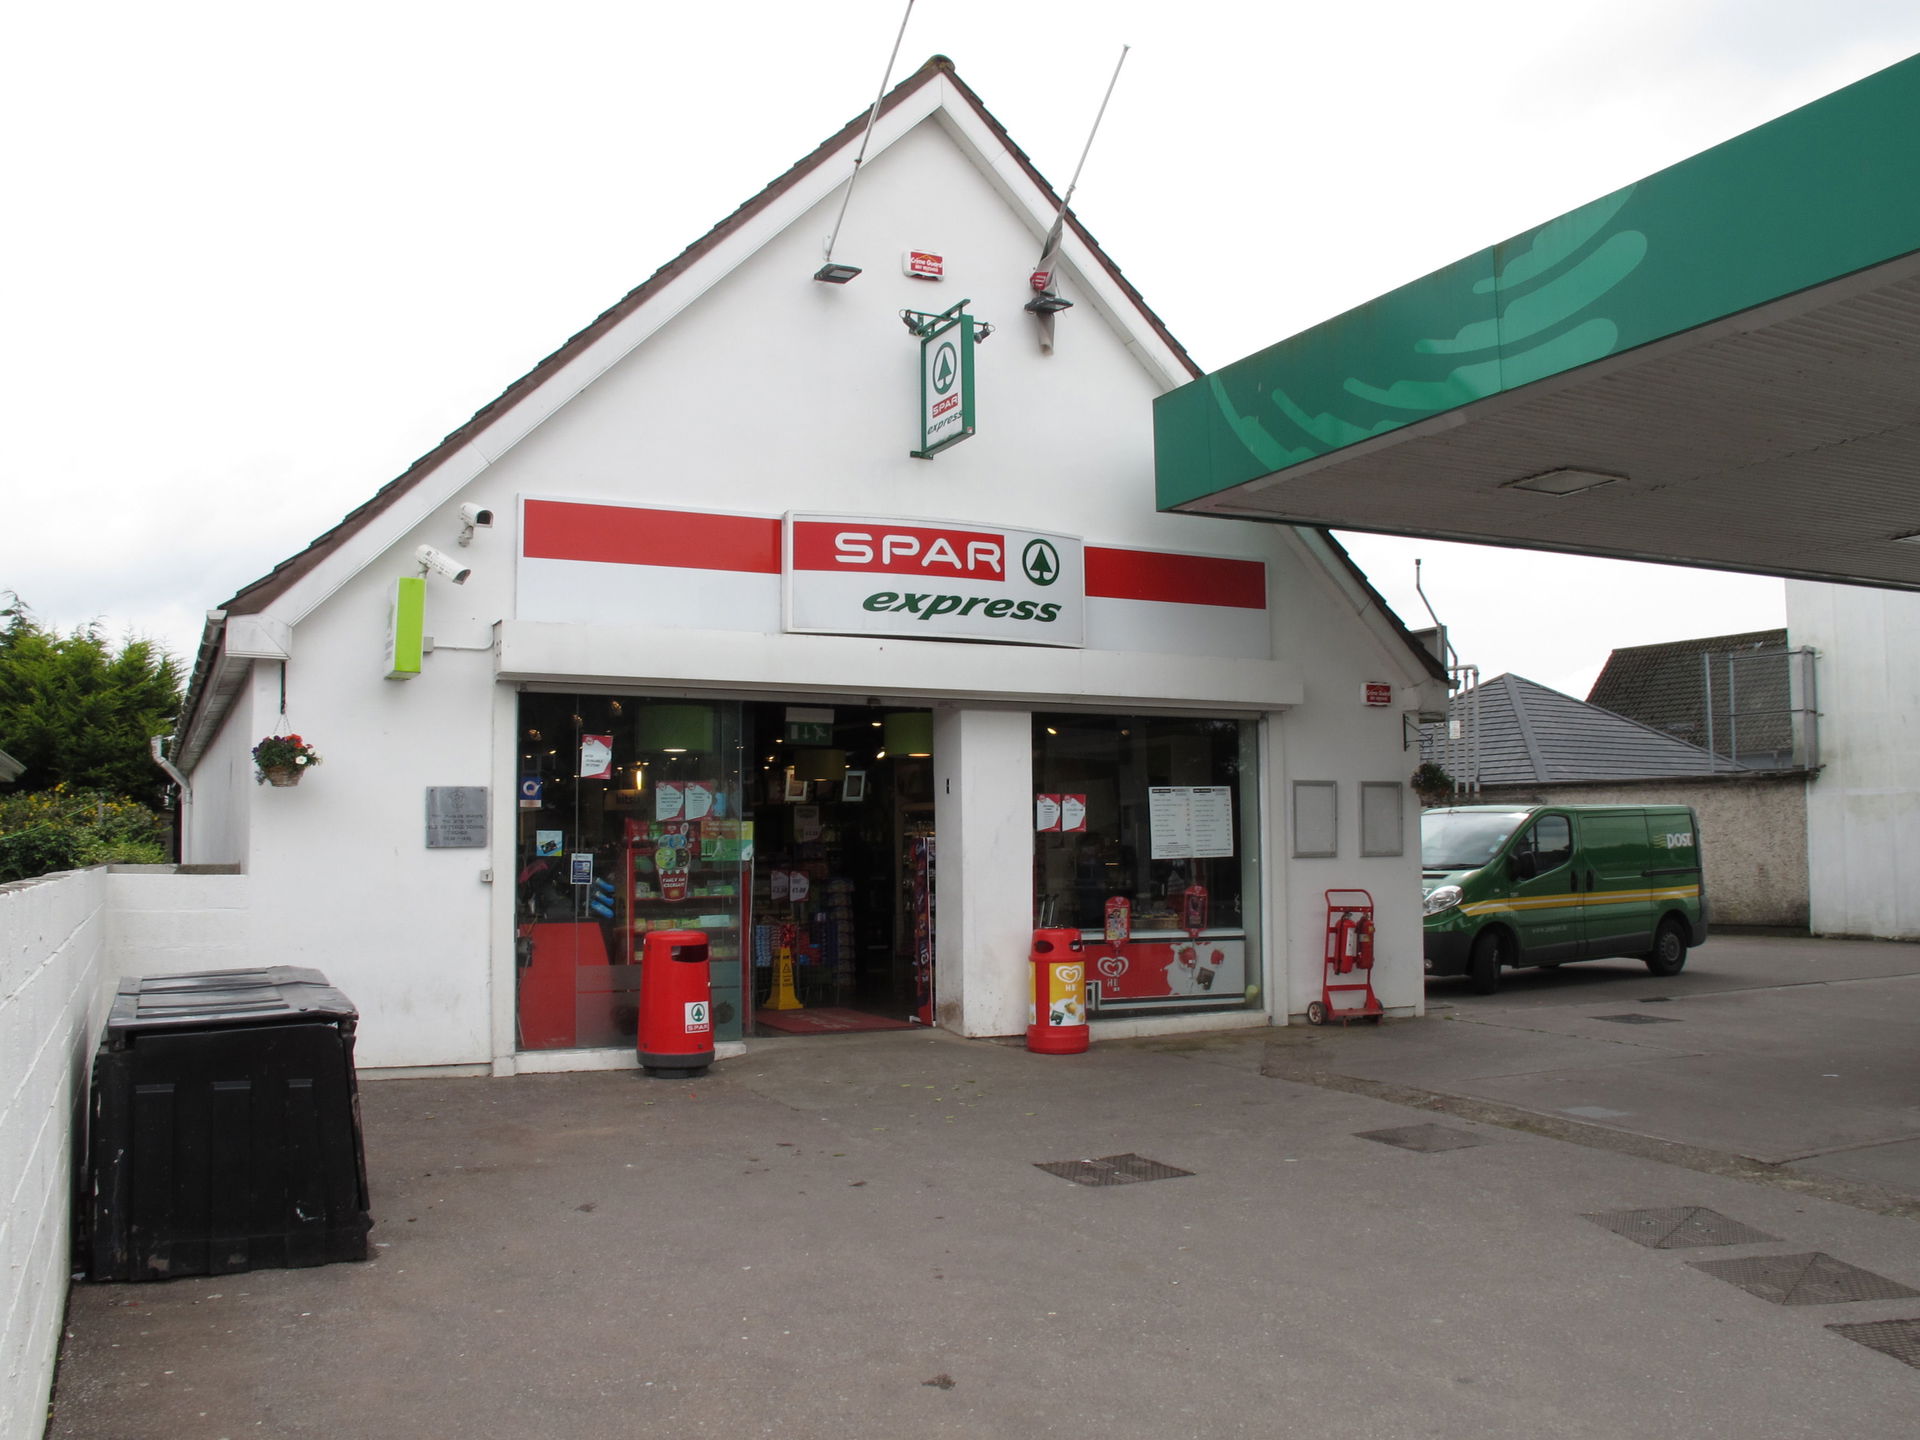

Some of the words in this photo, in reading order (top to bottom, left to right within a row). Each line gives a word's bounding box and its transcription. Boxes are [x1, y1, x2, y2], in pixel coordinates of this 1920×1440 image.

[932, 395, 958, 416] SPAR
[927, 410, 962, 435] express
[835, 532, 1001, 574] SPAR
[862, 591, 1062, 623] express
